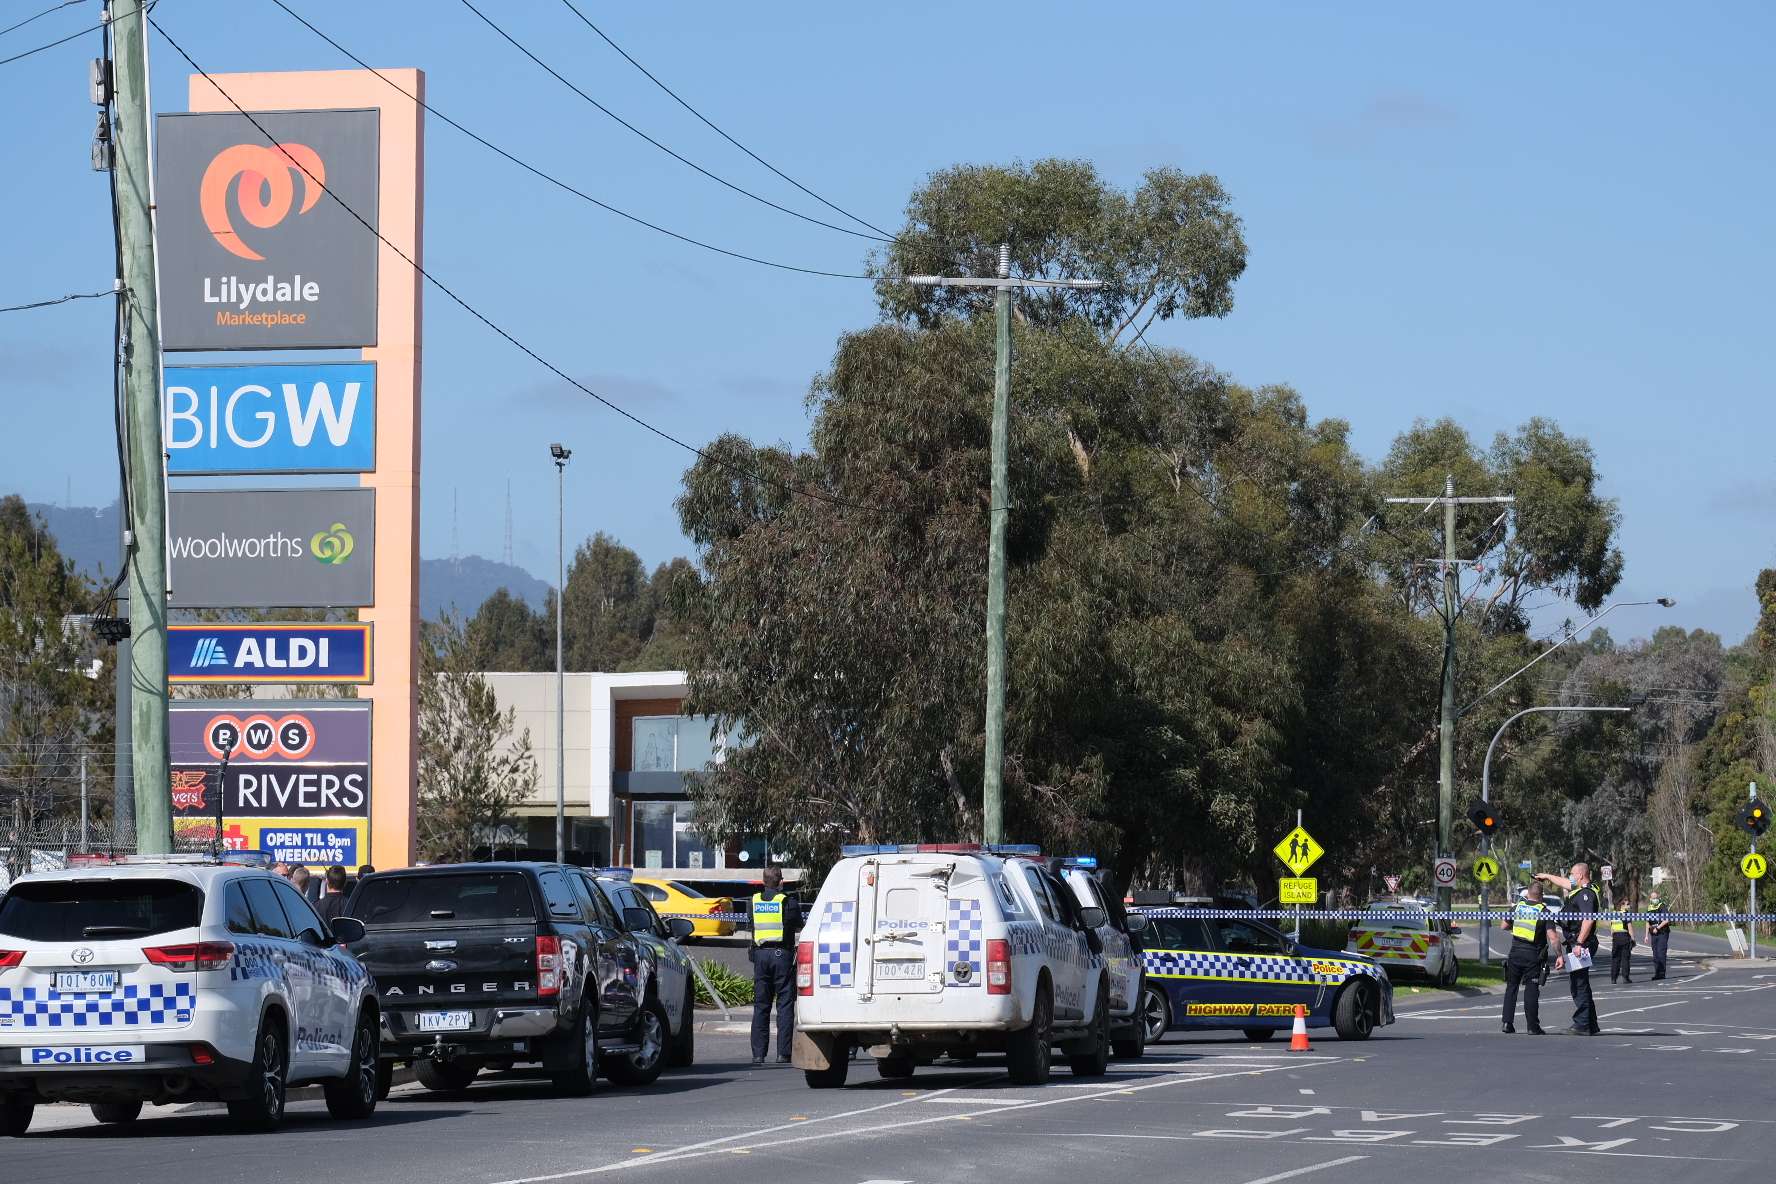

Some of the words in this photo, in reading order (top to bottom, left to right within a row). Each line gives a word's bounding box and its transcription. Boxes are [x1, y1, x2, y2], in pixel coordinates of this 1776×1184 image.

[204, 275, 319, 309] Lilydale
[216, 311, 306, 328] Marketplace
[169, 532, 303, 559] Woolworths
[234, 638, 329, 668] ALDI
[238, 774, 364, 808] RIVERS
[266, 833, 304, 847] OPEN
[307, 833, 325, 847] TIL
[327, 832, 351, 849] 9pm
[274, 848, 343, 862] WEEKDAYS
[1440, 868, 1453, 878] 40
[755, 904, 779, 912] Police
[877, 920, 928, 929] Police
[1313, 963, 1344, 974] Police
[386, 981, 530, 996] ANGER
[1187, 1005, 1252, 1015] HIGHWAY
[449, 1014, 468, 1026] 2PY
[32, 1048, 133, 1063] Police
